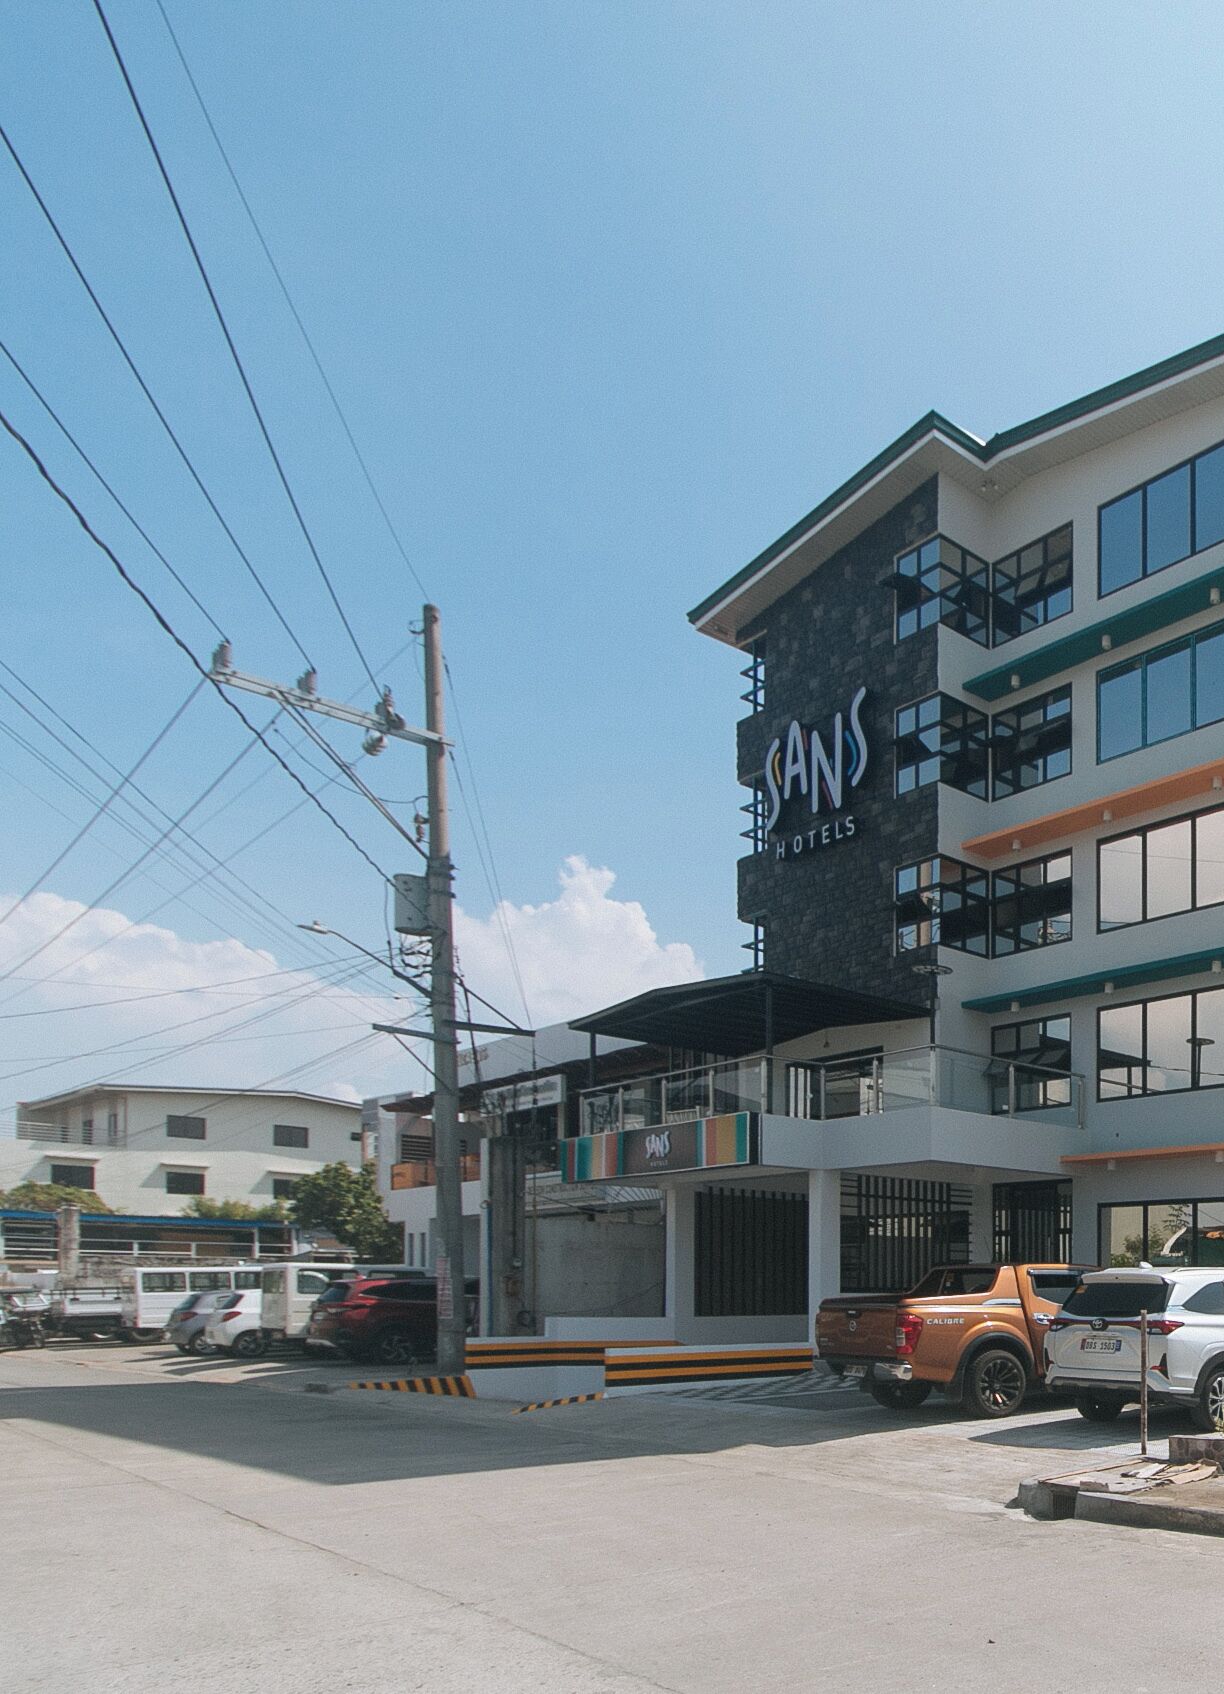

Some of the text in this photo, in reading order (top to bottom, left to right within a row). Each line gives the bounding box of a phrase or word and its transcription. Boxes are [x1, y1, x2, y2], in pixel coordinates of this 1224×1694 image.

[765, 686, 868, 831] SANS
[776, 816, 856, 859] HOTELS
[645, 1131, 670, 1159] SANS
[926, 1317, 966, 1325] CALIBRE
